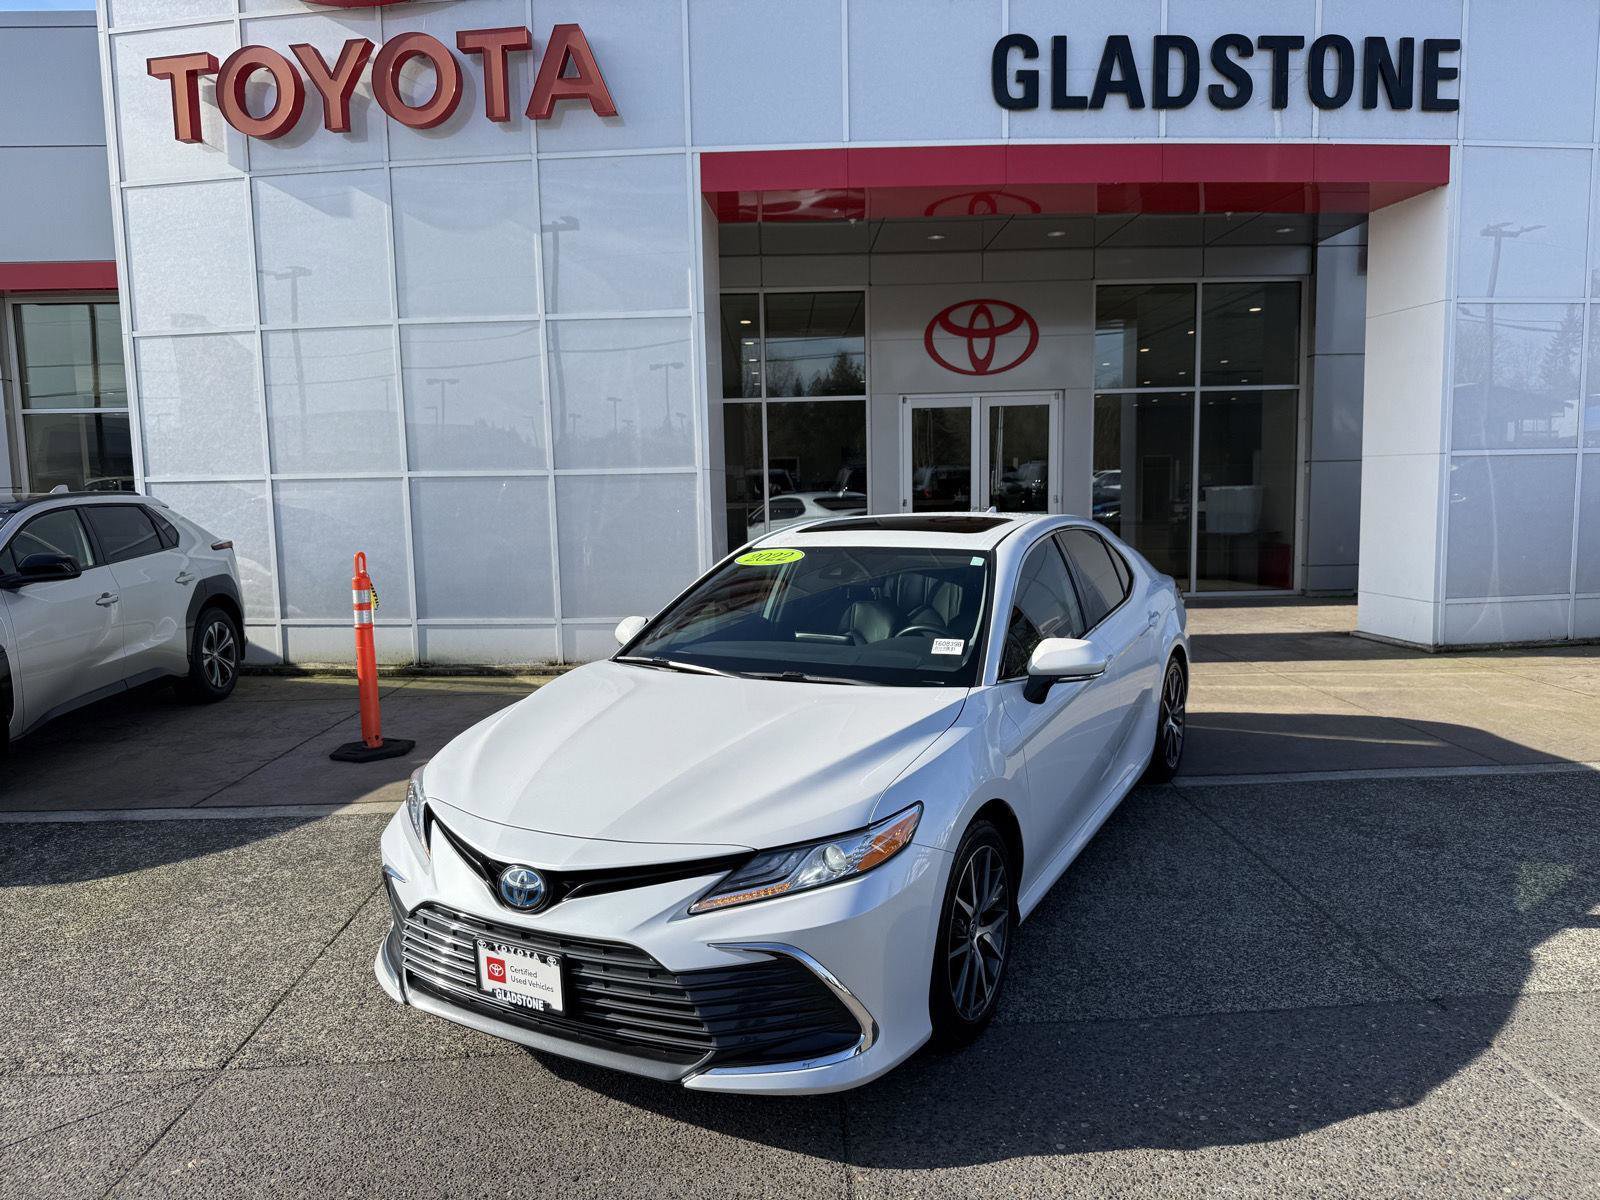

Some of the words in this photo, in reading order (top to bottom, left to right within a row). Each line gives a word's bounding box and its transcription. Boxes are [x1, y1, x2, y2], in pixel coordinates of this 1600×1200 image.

[992, 34, 1461, 111] GLADSTONE
[147, 24, 618, 144] TOYOTA
[744, 552, 795, 562] 2022
[494, 943, 540, 961] TOYOTA
[509, 965, 538, 978] Certified
[510, 975, 527, 986] Used
[527, 979, 554, 993] Vehicles
[495, 988, 544, 1011] GLADSTONE
